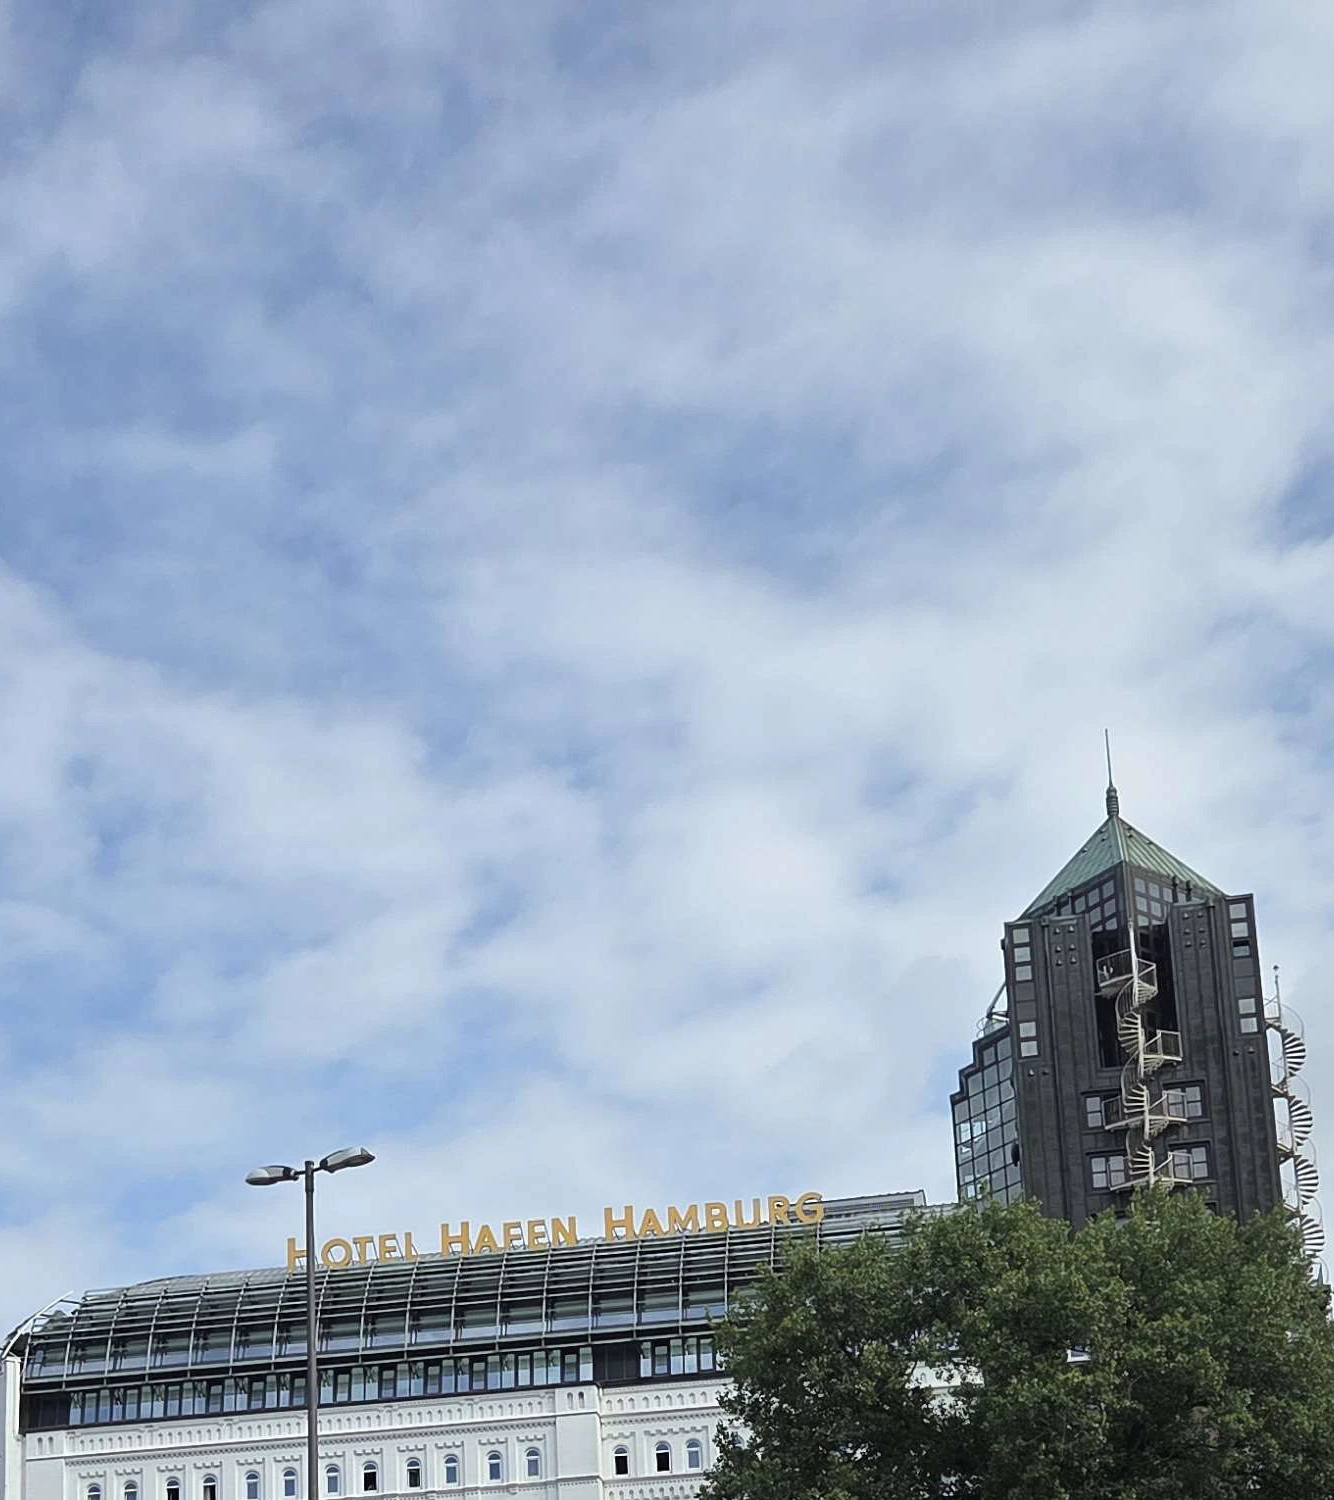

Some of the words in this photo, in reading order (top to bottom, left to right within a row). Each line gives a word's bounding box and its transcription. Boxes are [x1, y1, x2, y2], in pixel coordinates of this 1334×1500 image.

[287, 1231, 418, 1273] HOTEL
[440, 1216, 578, 1257] HAFEN
[603, 1191, 824, 1242] HAMBURG
